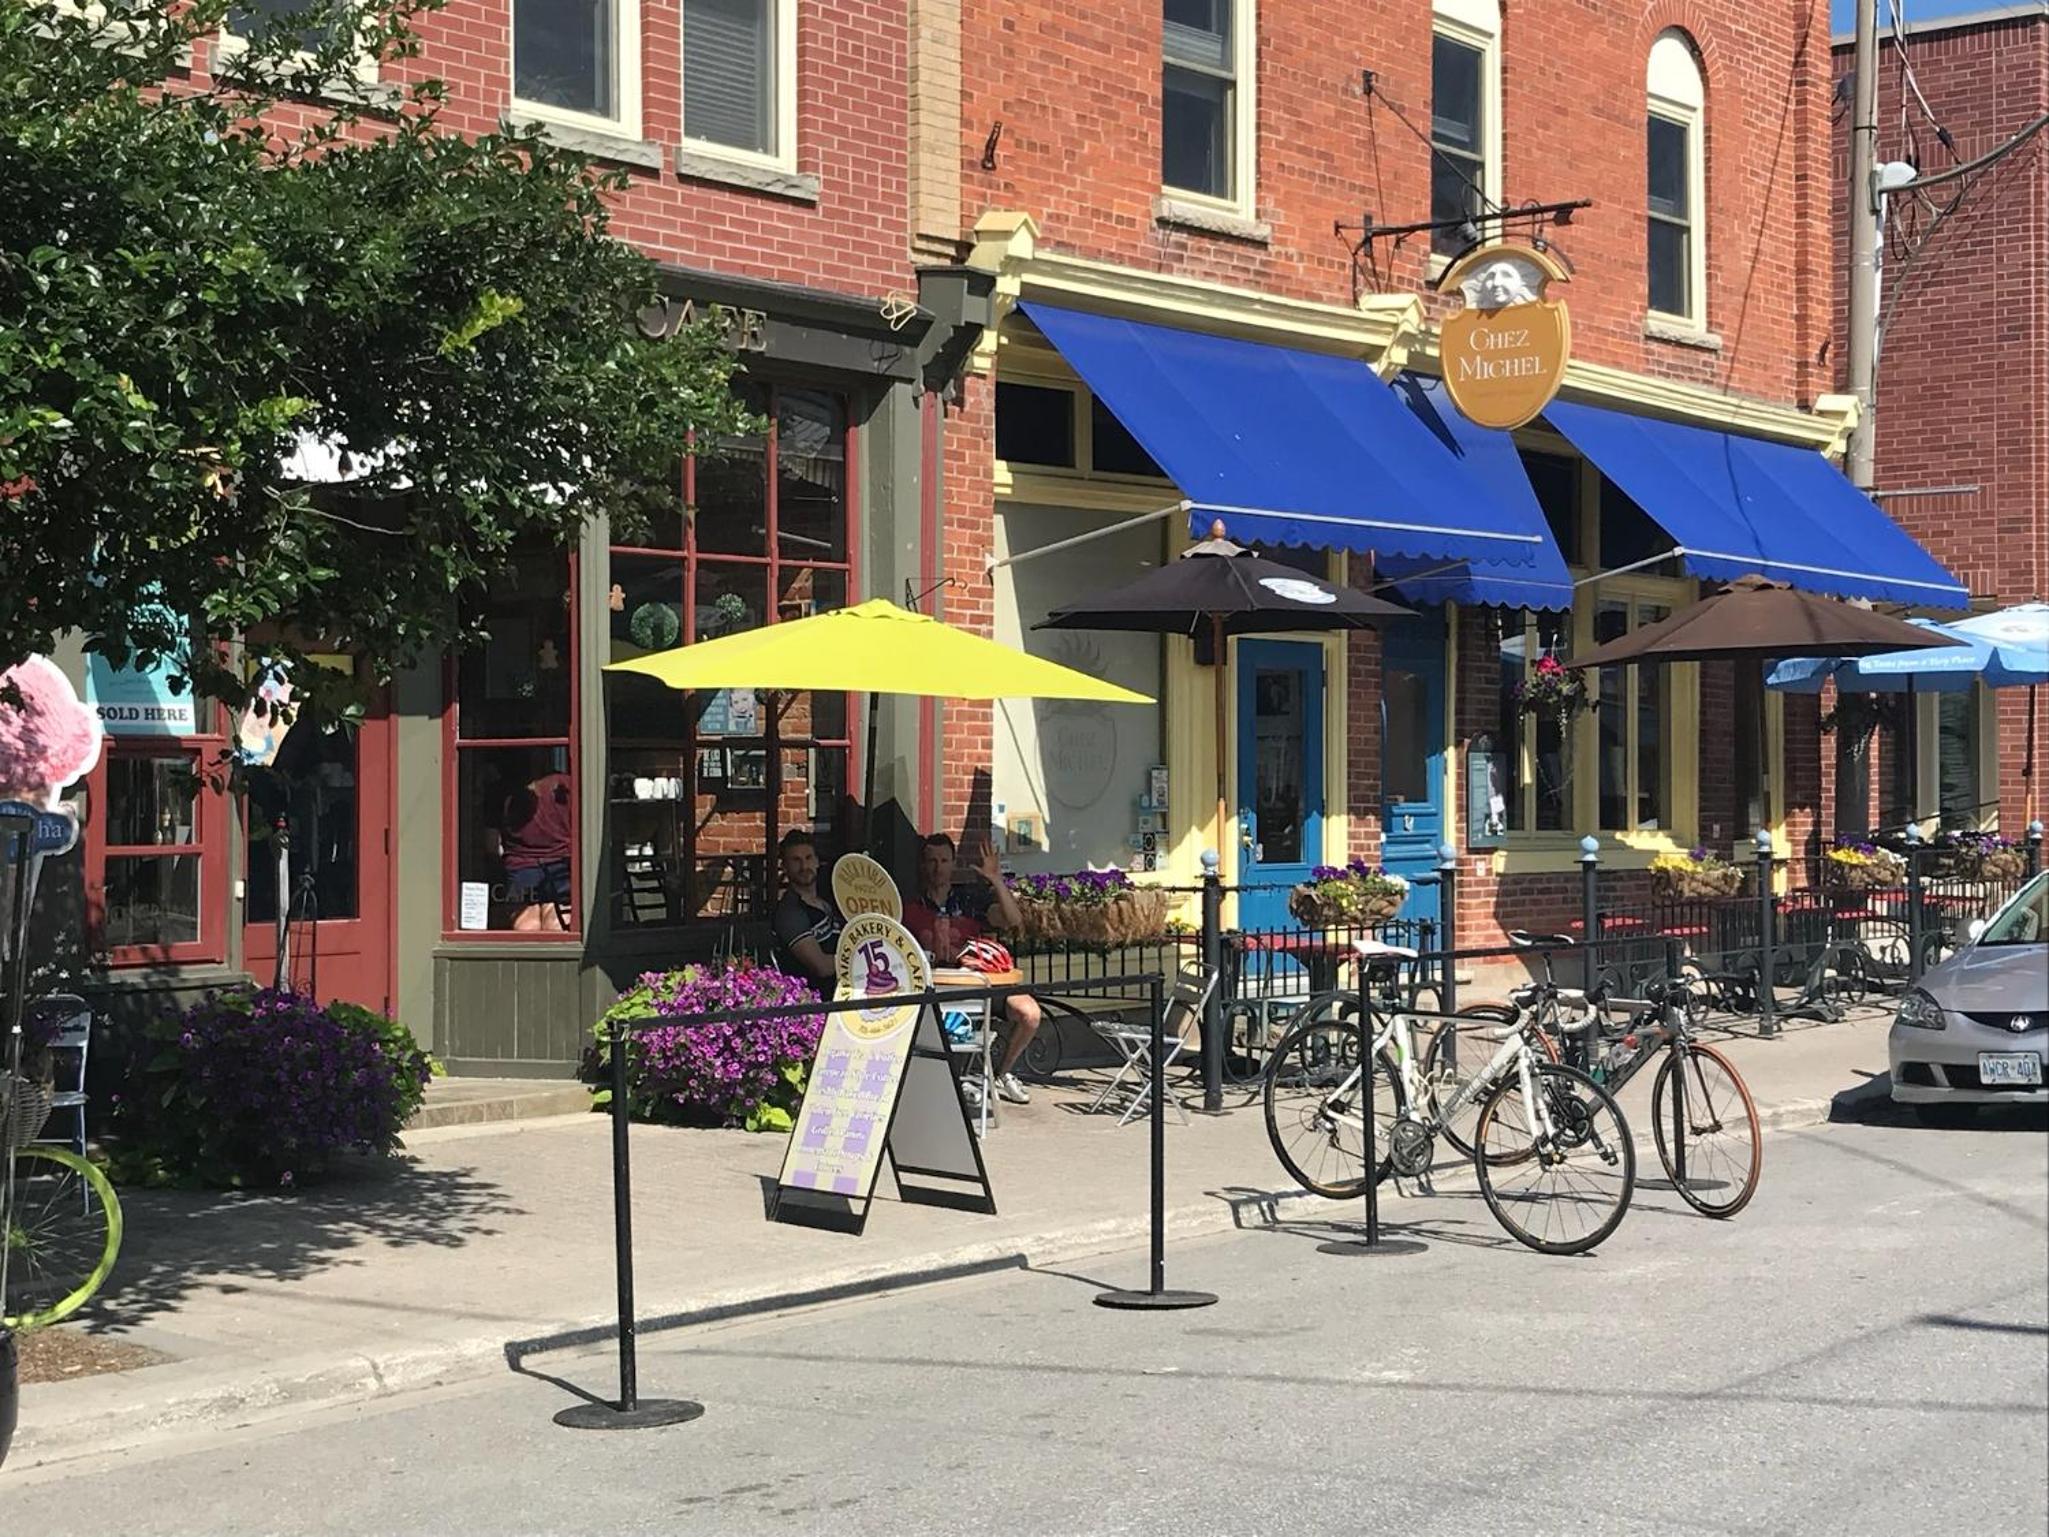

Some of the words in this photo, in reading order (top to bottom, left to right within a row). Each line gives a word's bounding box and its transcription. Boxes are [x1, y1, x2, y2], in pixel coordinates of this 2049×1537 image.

[1469, 327, 1530, 351] CHEZ
[1459, 355, 1547, 381] MICHEL
[96, 706, 139, 720] SOLD
[144, 707, 189, 721] HERE
[846, 896, 894, 917] OPEN
[849, 921, 892, 945] BAKERY
[895, 936, 904, 947] &
[857, 939, 890, 976] 15
